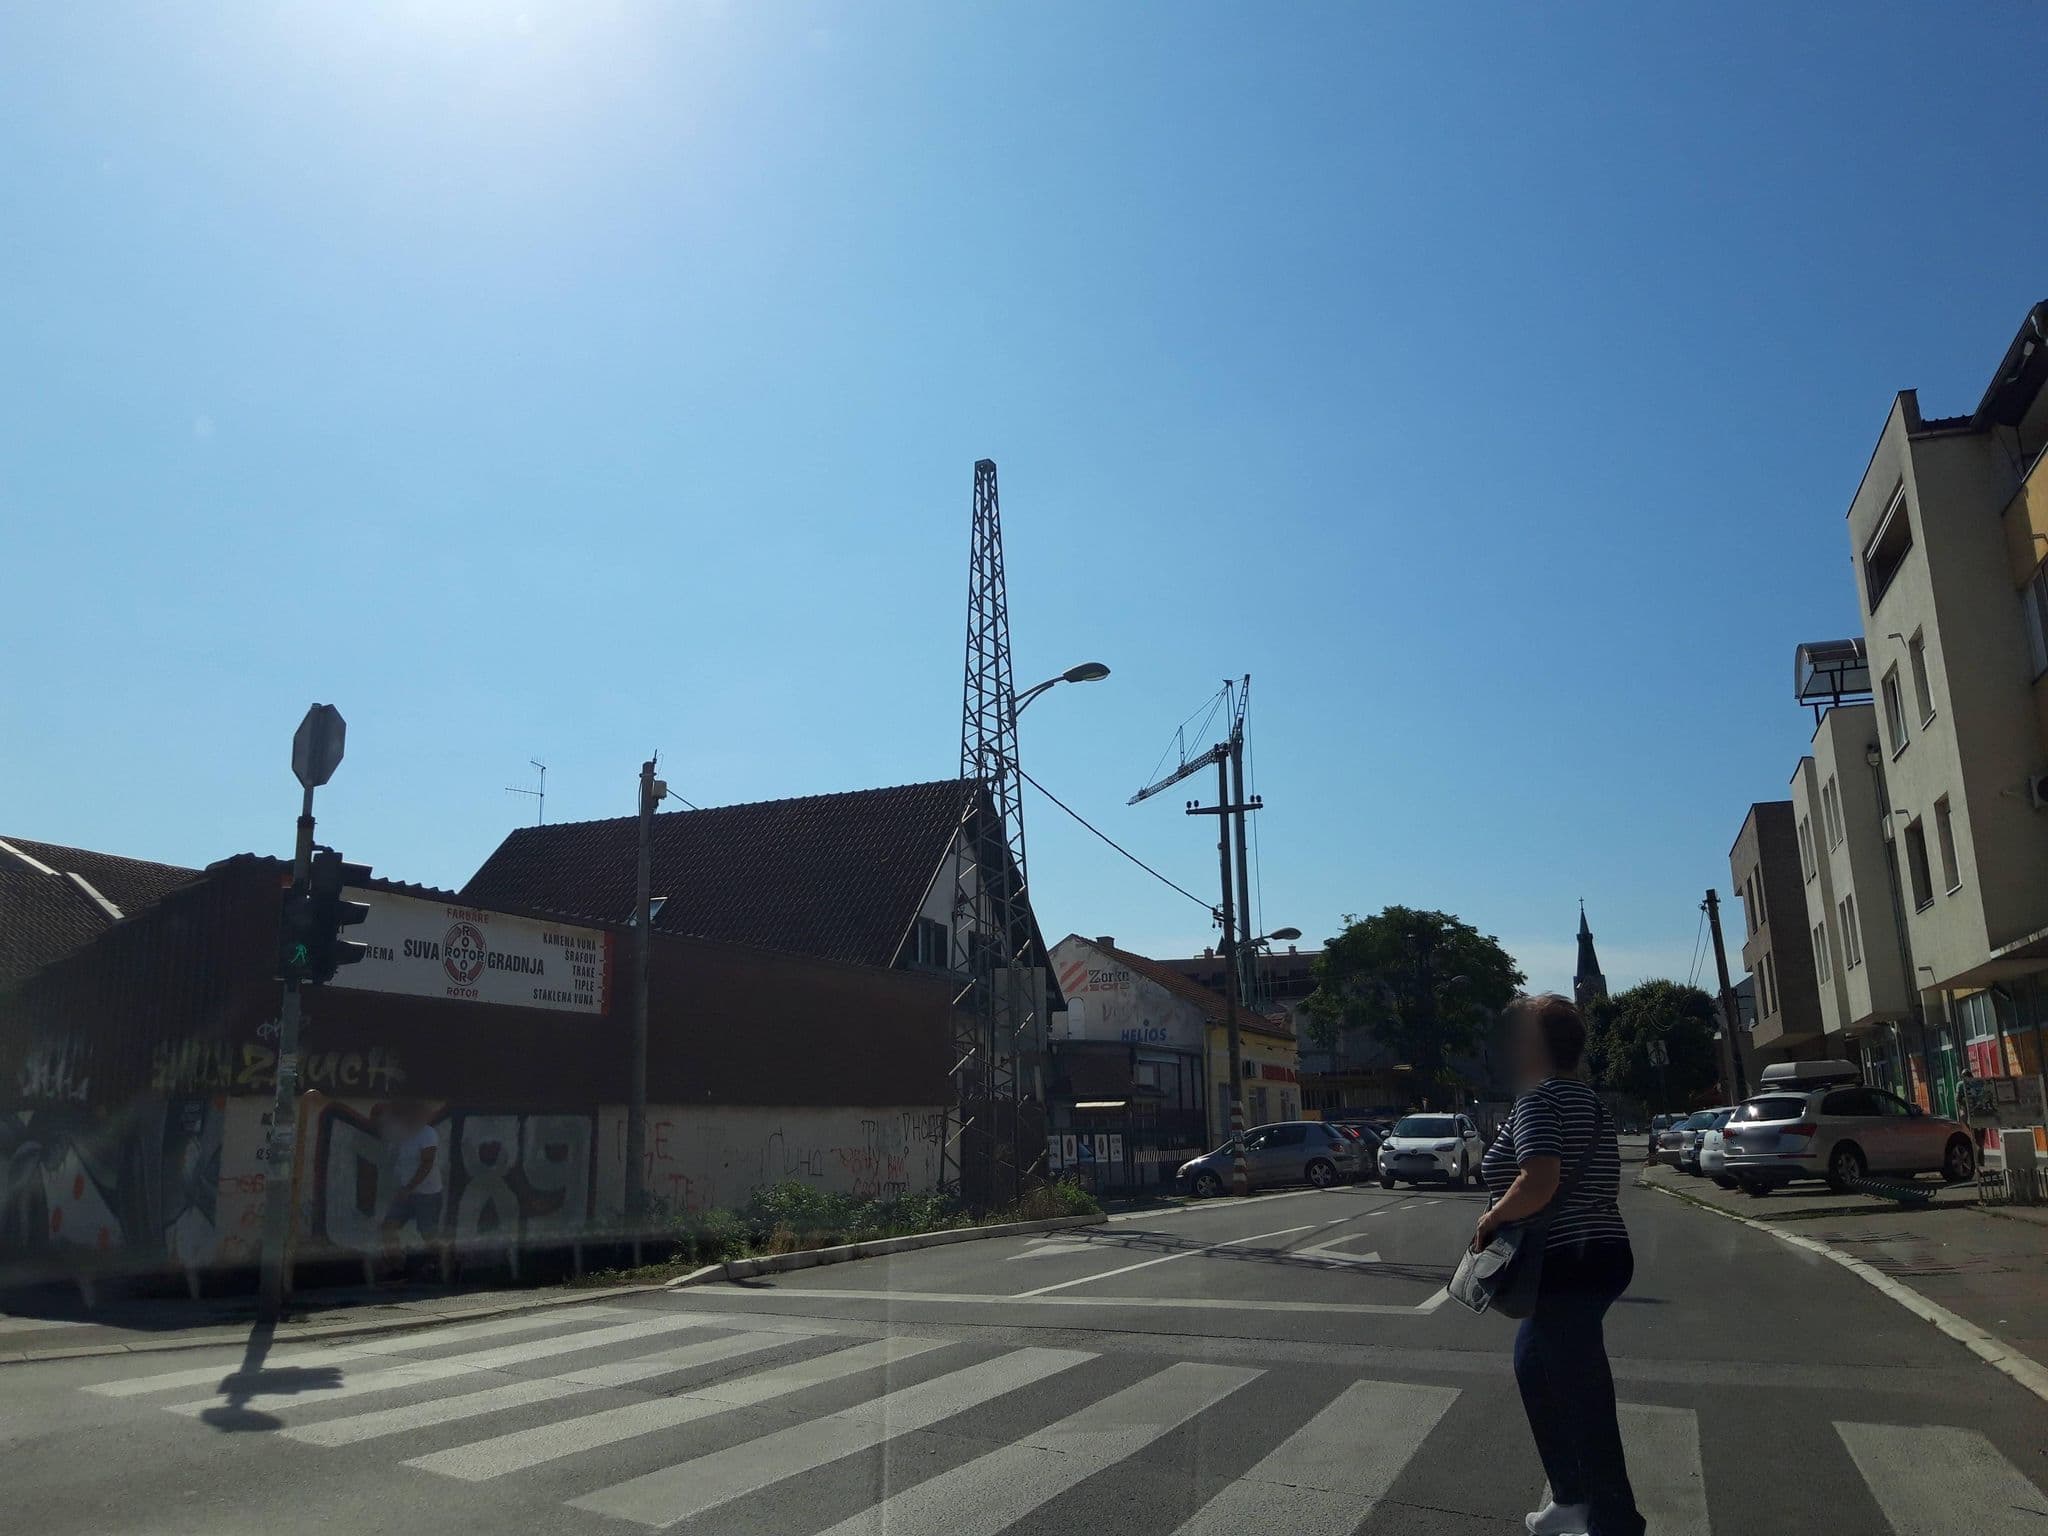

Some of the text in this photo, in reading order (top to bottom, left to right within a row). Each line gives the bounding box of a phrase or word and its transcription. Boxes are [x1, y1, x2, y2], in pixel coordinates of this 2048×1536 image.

[364, 938, 440, 961] REMA SUVA
[543, 931, 597, 951] KAMENA VUNA
[444, 946, 485, 962] ROTOR
[487, 951, 545, 976] GRADNJA
[572, 964, 596, 979] TRAKE
[446, 986, 480, 999] ROTOR
[574, 978, 595, 992] TIPLE
[533, 987, 594, 1006] STAKLENA VUNA
